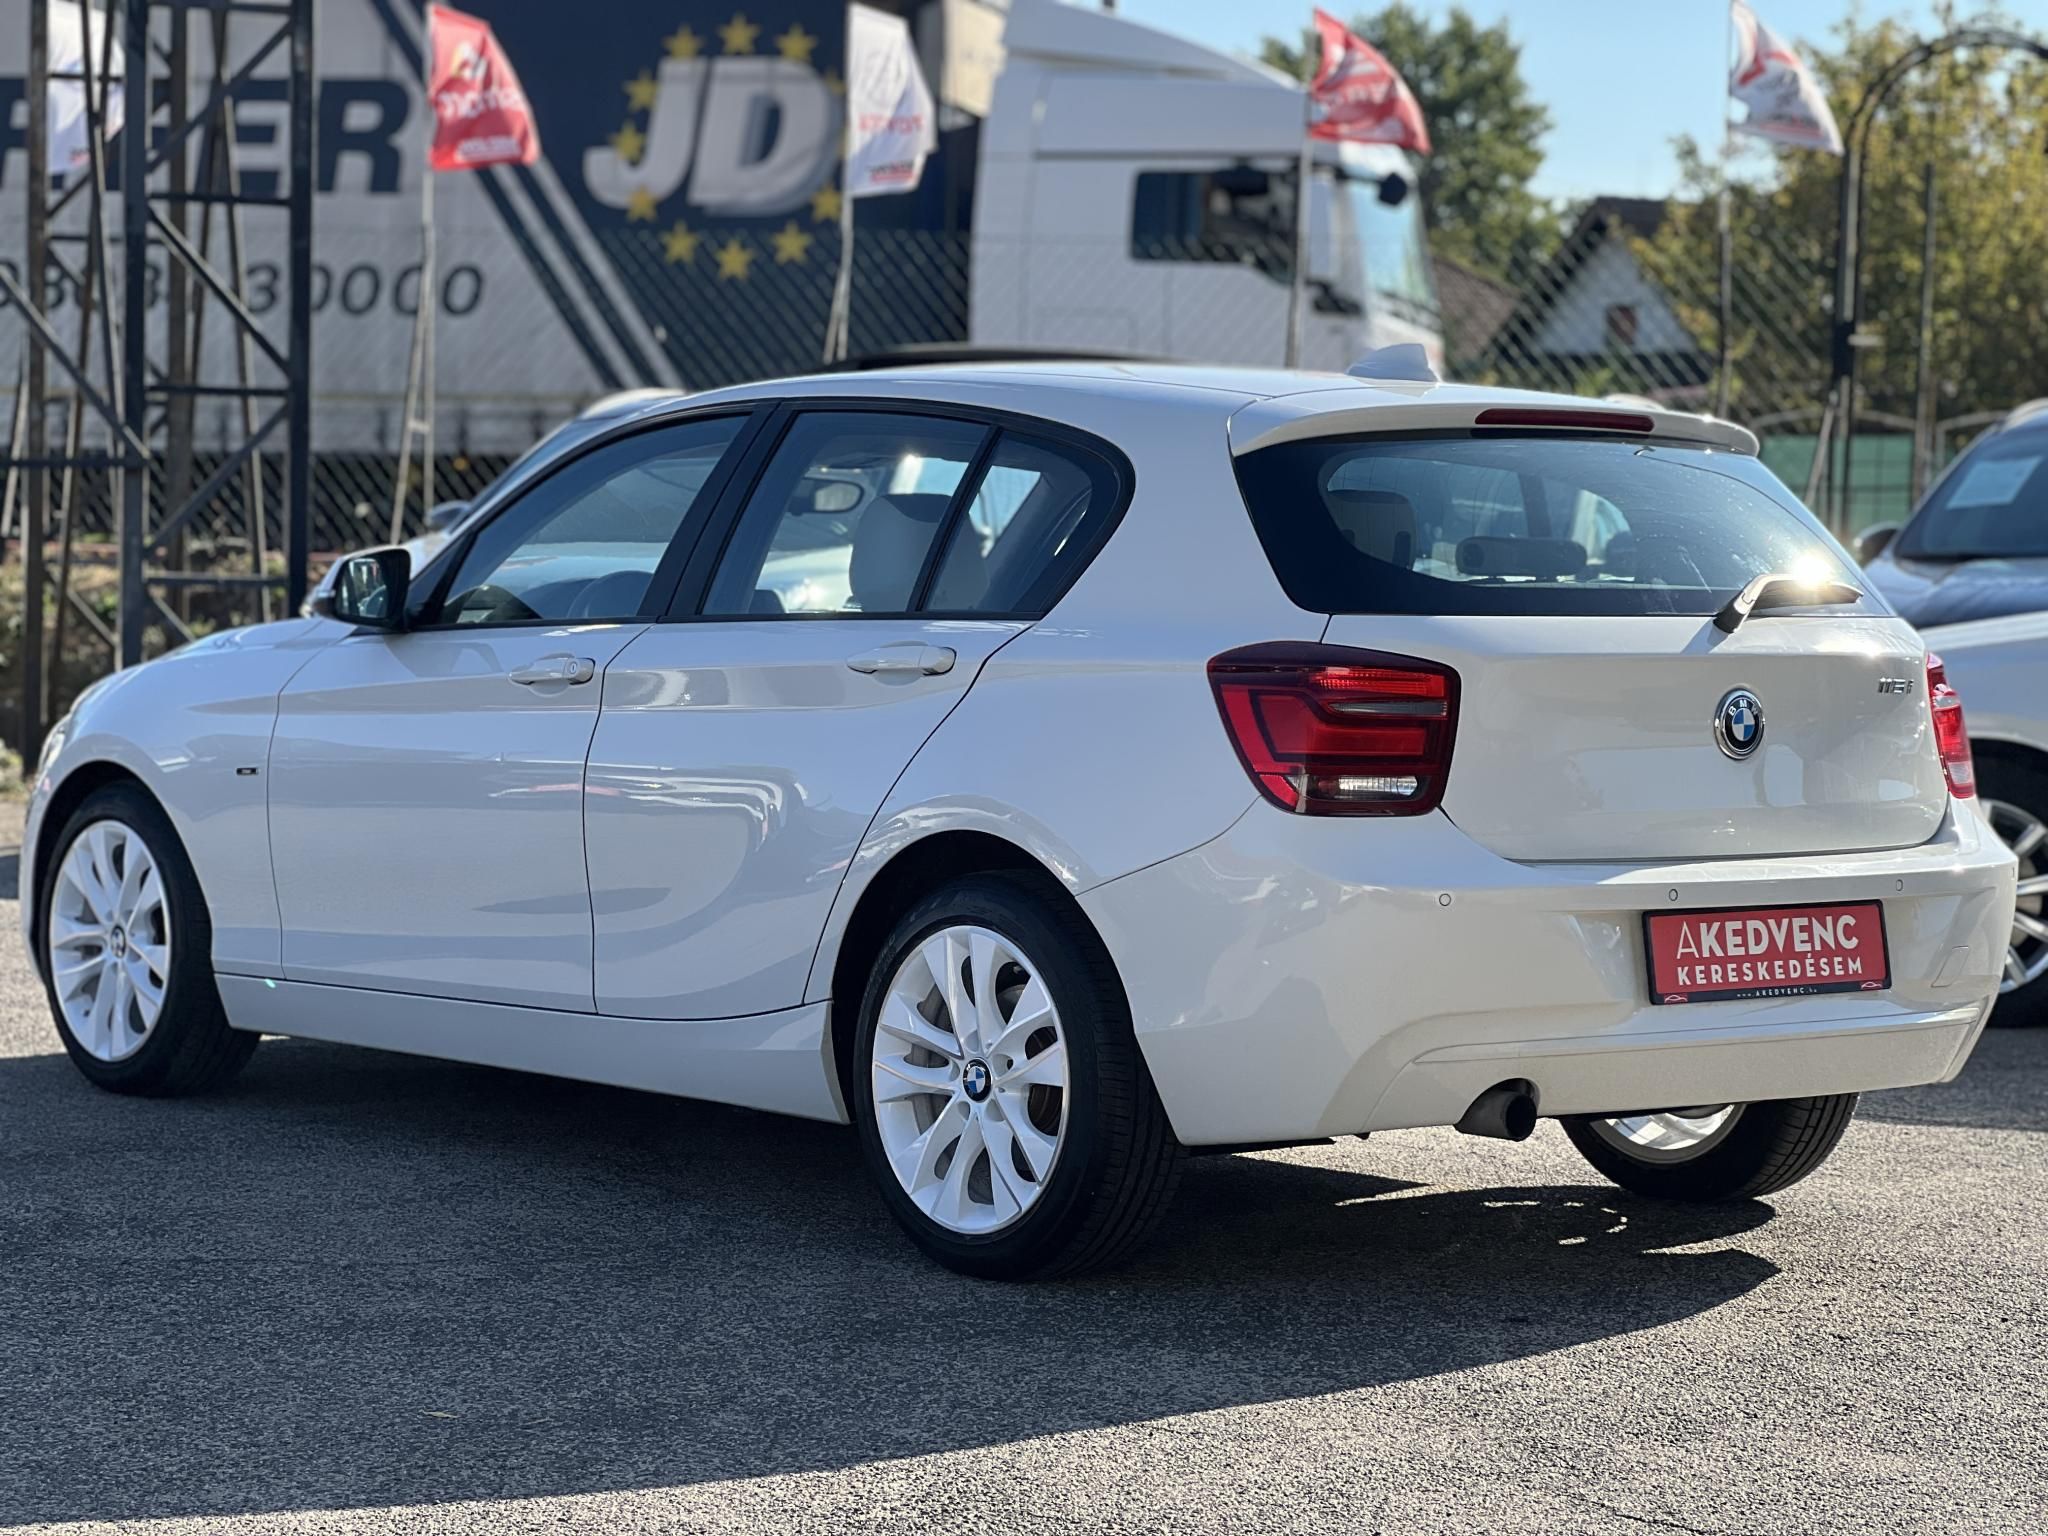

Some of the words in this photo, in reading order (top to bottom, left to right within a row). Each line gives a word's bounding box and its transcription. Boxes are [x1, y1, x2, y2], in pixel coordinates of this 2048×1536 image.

[582, 55, 838, 213] JD
[1728, 699, 1760, 716] BMW
[1676, 914, 1860, 960] AKEDVENC
[1677, 953, 1863, 986] KERESKEDÉSEM
